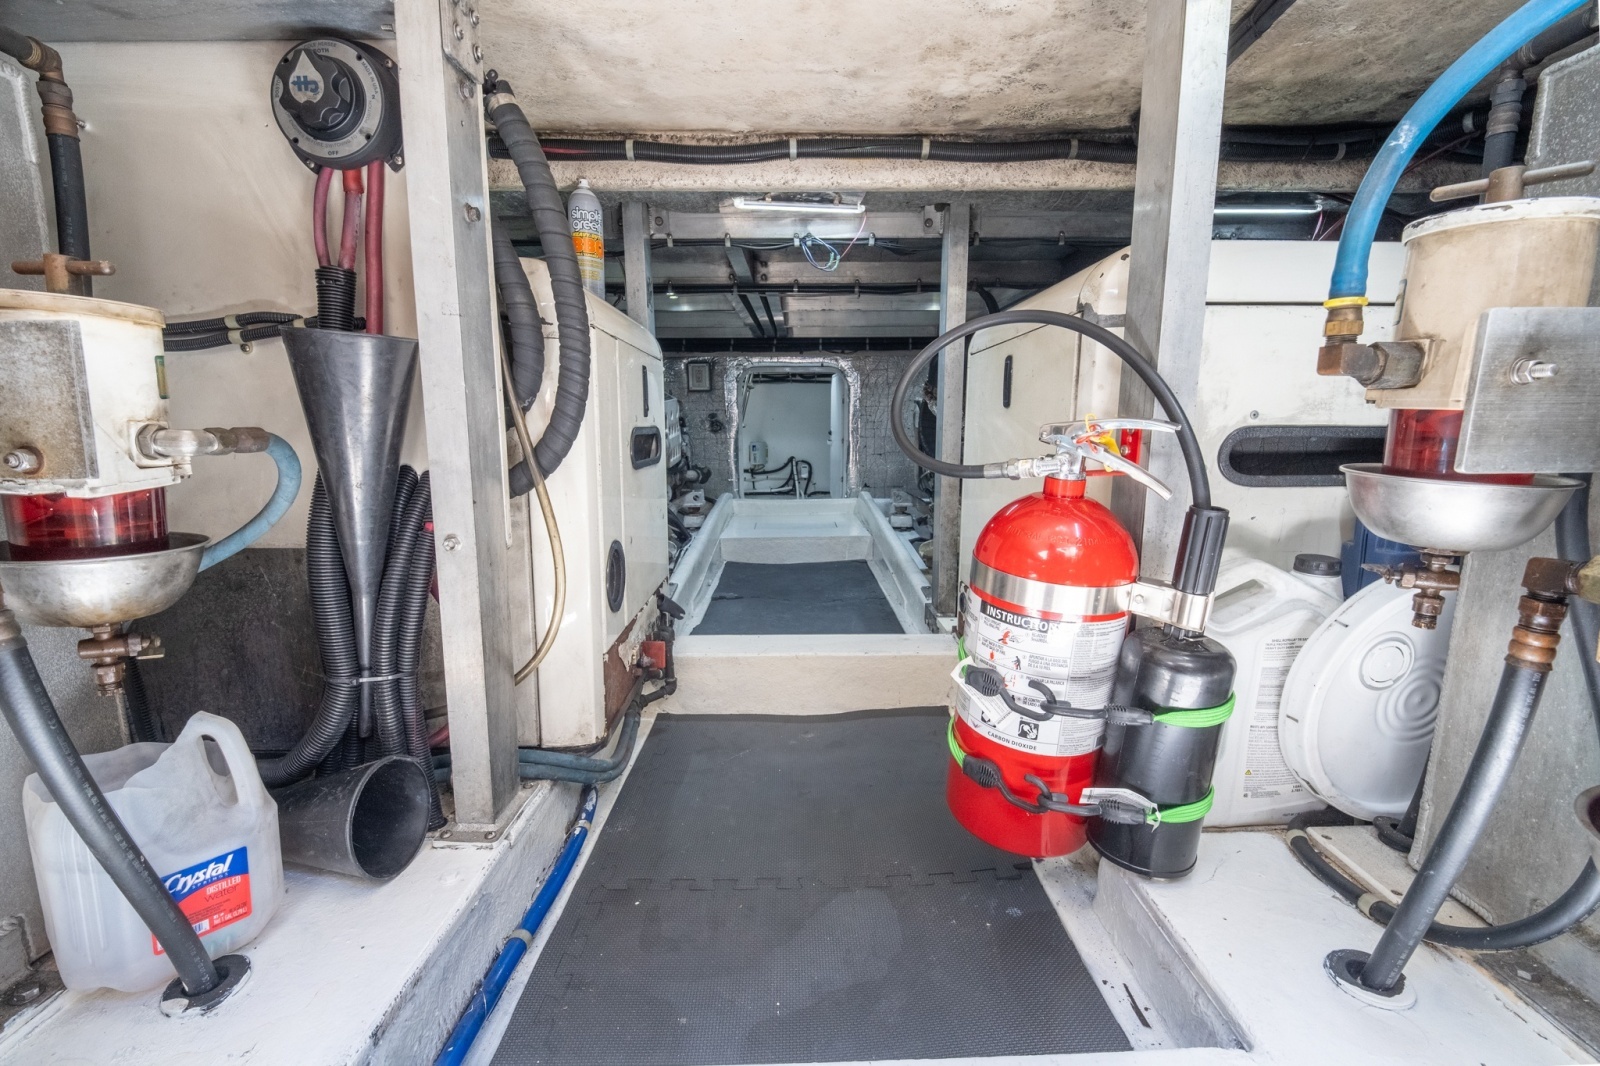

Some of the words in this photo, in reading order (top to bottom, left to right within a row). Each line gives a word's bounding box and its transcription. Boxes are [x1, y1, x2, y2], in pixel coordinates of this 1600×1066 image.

[361, 61, 373, 77] MADE
[571, 206, 601, 222] simple
[987, 731, 1010, 744] CARBON
[1011, 740, 1037, 751] DIOXIDE
[164, 853, 234, 895] Crystal
[191, 872, 229, 890] SPRINGS
[204, 884, 240, 903] water
[206, 875, 241, 896] DISTILLED
